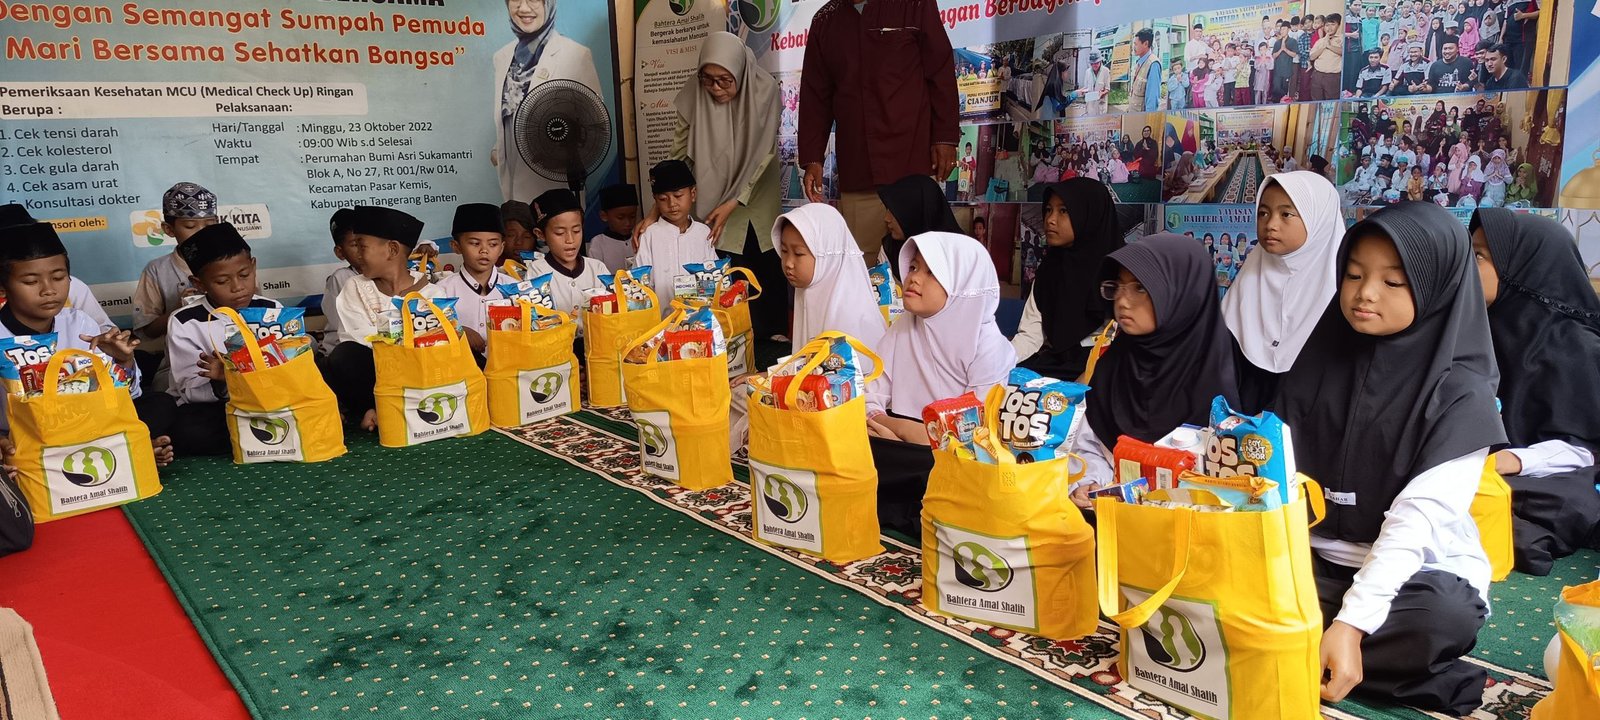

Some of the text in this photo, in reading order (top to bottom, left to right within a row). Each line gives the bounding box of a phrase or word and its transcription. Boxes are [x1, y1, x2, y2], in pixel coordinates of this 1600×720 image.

[984, 0, 1064, 18] Berbag
[124, 4, 271, 33] Semangat
[281, 9, 384, 35] Sumpah
[393, 14, 485, 36] Pemuda
[650, 29, 675, 38] Bergerak
[675, 26, 696, 35] berkarya
[651, 31, 709, 45] kemaslahatan Manusia
[7, 37, 81, 60] Mari
[93, 39, 224, 61] Bersama
[235, 42, 359, 64] Sehatkan
[0, 86, 353, 98] Pemeriksaan Kesehatan MCU (Medical Check Up) Ringan
[216, 102, 293, 113] Pelaksanaan:
[967, 95, 999, 106] CIANJUR
[2, 104, 53, 117] Berupa
[0, 127, 118, 140] 1. Cek tensi darah
[212, 122, 285, 134] Hari/Tanggal
[349, 122, 361, 132] 23
[364, 121, 406, 132] Oktober
[408, 121, 433, 132] 2022
[214, 139, 252, 149] Waktu
[337, 137, 358, 147] Wib
[361, 137, 375, 147] s.d
[378, 136, 413, 147] Selesai
[1, 144, 112, 158] 2. Cek kolesterol
[216, 154, 260, 166] Tempat
[369, 151, 395, 162] Bumi
[397, 151, 417, 161] Asri
[419, 149, 473, 160] Sukamantri
[4, 161, 119, 176] 3. Cek gula darah
[307, 164, 458, 179] Blok A, No 27, Rt 001/Rw 014,
[6, 179, 118, 193] 4. Cek asam urat
[309, 179, 432, 194] Kecamatan Pasar Kemis,
[25, 196, 95, 210] Konsultasi
[98, 194, 140, 206] dokter
[311, 193, 457, 209] Kabupaten Tangerang Banten
[79, 218, 105, 228] oleh:
[233, 213, 261, 225] KITA
[1184, 215, 1252, 223] BAHTERA AMAL
[263, 280, 291, 290] Shalih
[411, 313, 440, 331] OS
[6, 345, 51, 367] TOS
[1000, 385, 1042, 416] TOS
[1000, 411, 1051, 441] TOS
[1204, 434, 1239, 466] OS
[60, 485, 128, 505] Bahtera Amal Shalih
[763, 523, 783, 535] Bahtera
[797, 531, 815, 542] Shalih
[946, 593, 1026, 614] Bahtera Amal Shalih
[1134, 665, 1218, 704] Bahtera Amal Shalih
